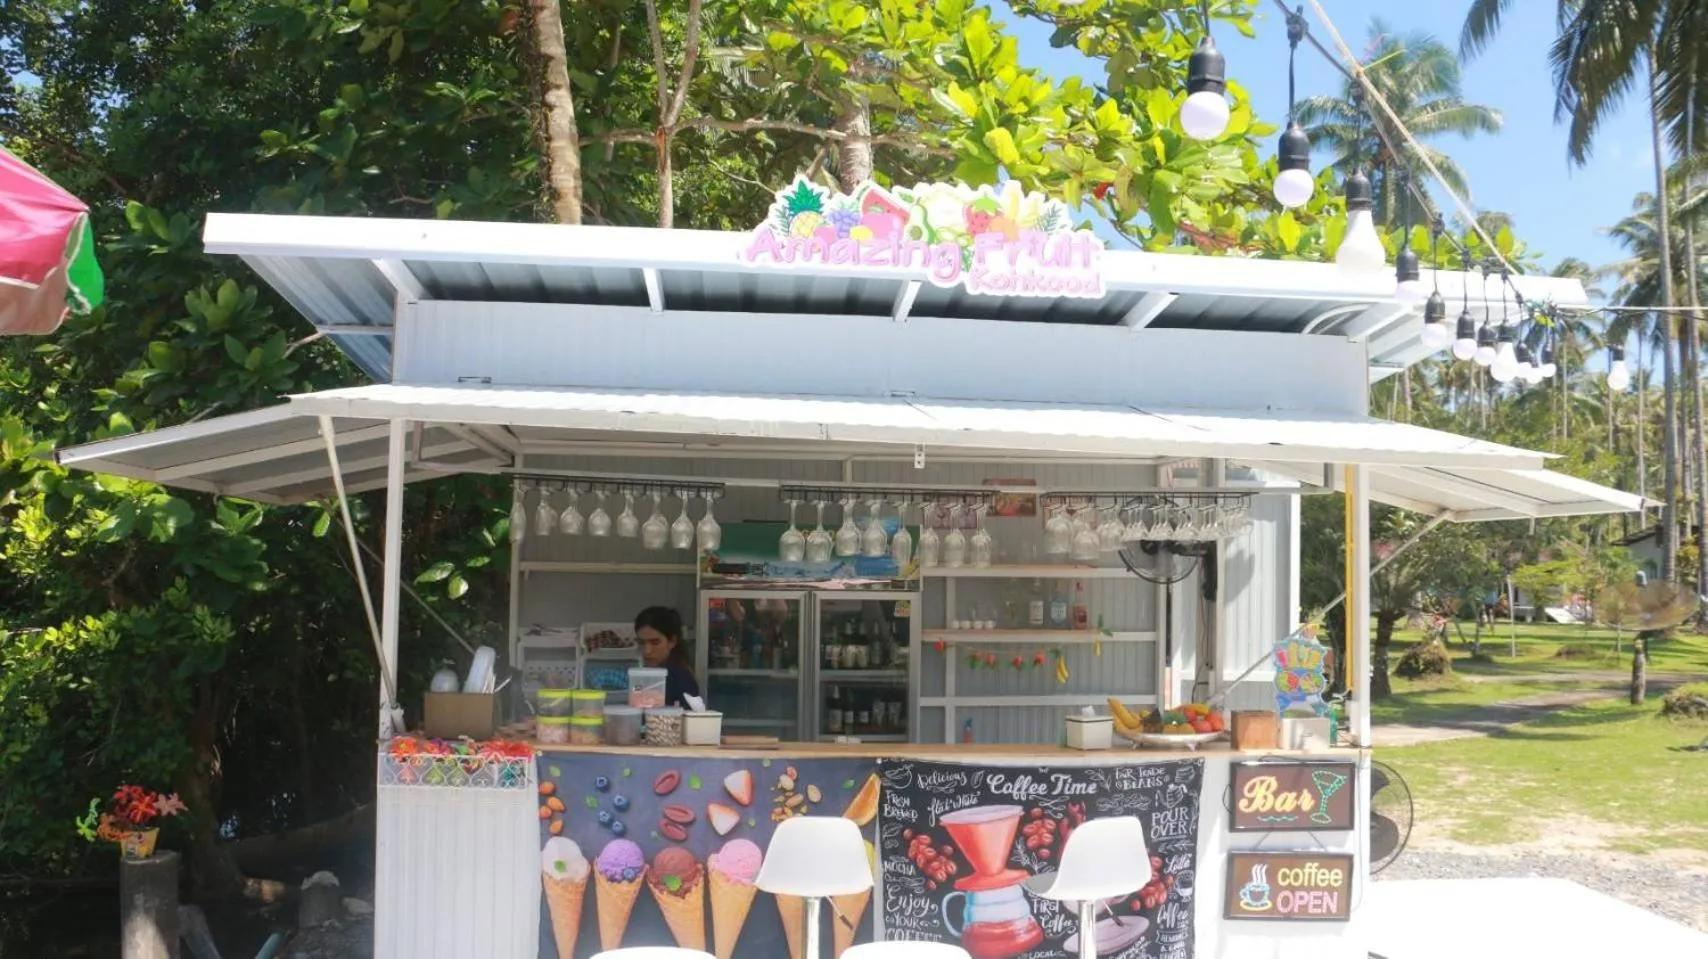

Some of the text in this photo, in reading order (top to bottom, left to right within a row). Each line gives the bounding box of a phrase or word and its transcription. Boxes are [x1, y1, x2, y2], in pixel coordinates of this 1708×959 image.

[748, 229, 1101, 281] Amazing Fruit
[917, 769, 967, 790] Delicious
[986, 773, 1097, 801] Coffee Time
[1122, 776, 1164, 790] BEANS
[1238, 775, 1315, 813] Bar
[1151, 806, 1189, 827] POUR
[1150, 820, 1187, 839] OVER
[1277, 862, 1343, 887] coffee
[886, 884, 930, 918] Enjoy
[1276, 890, 1339, 914] OPEN
